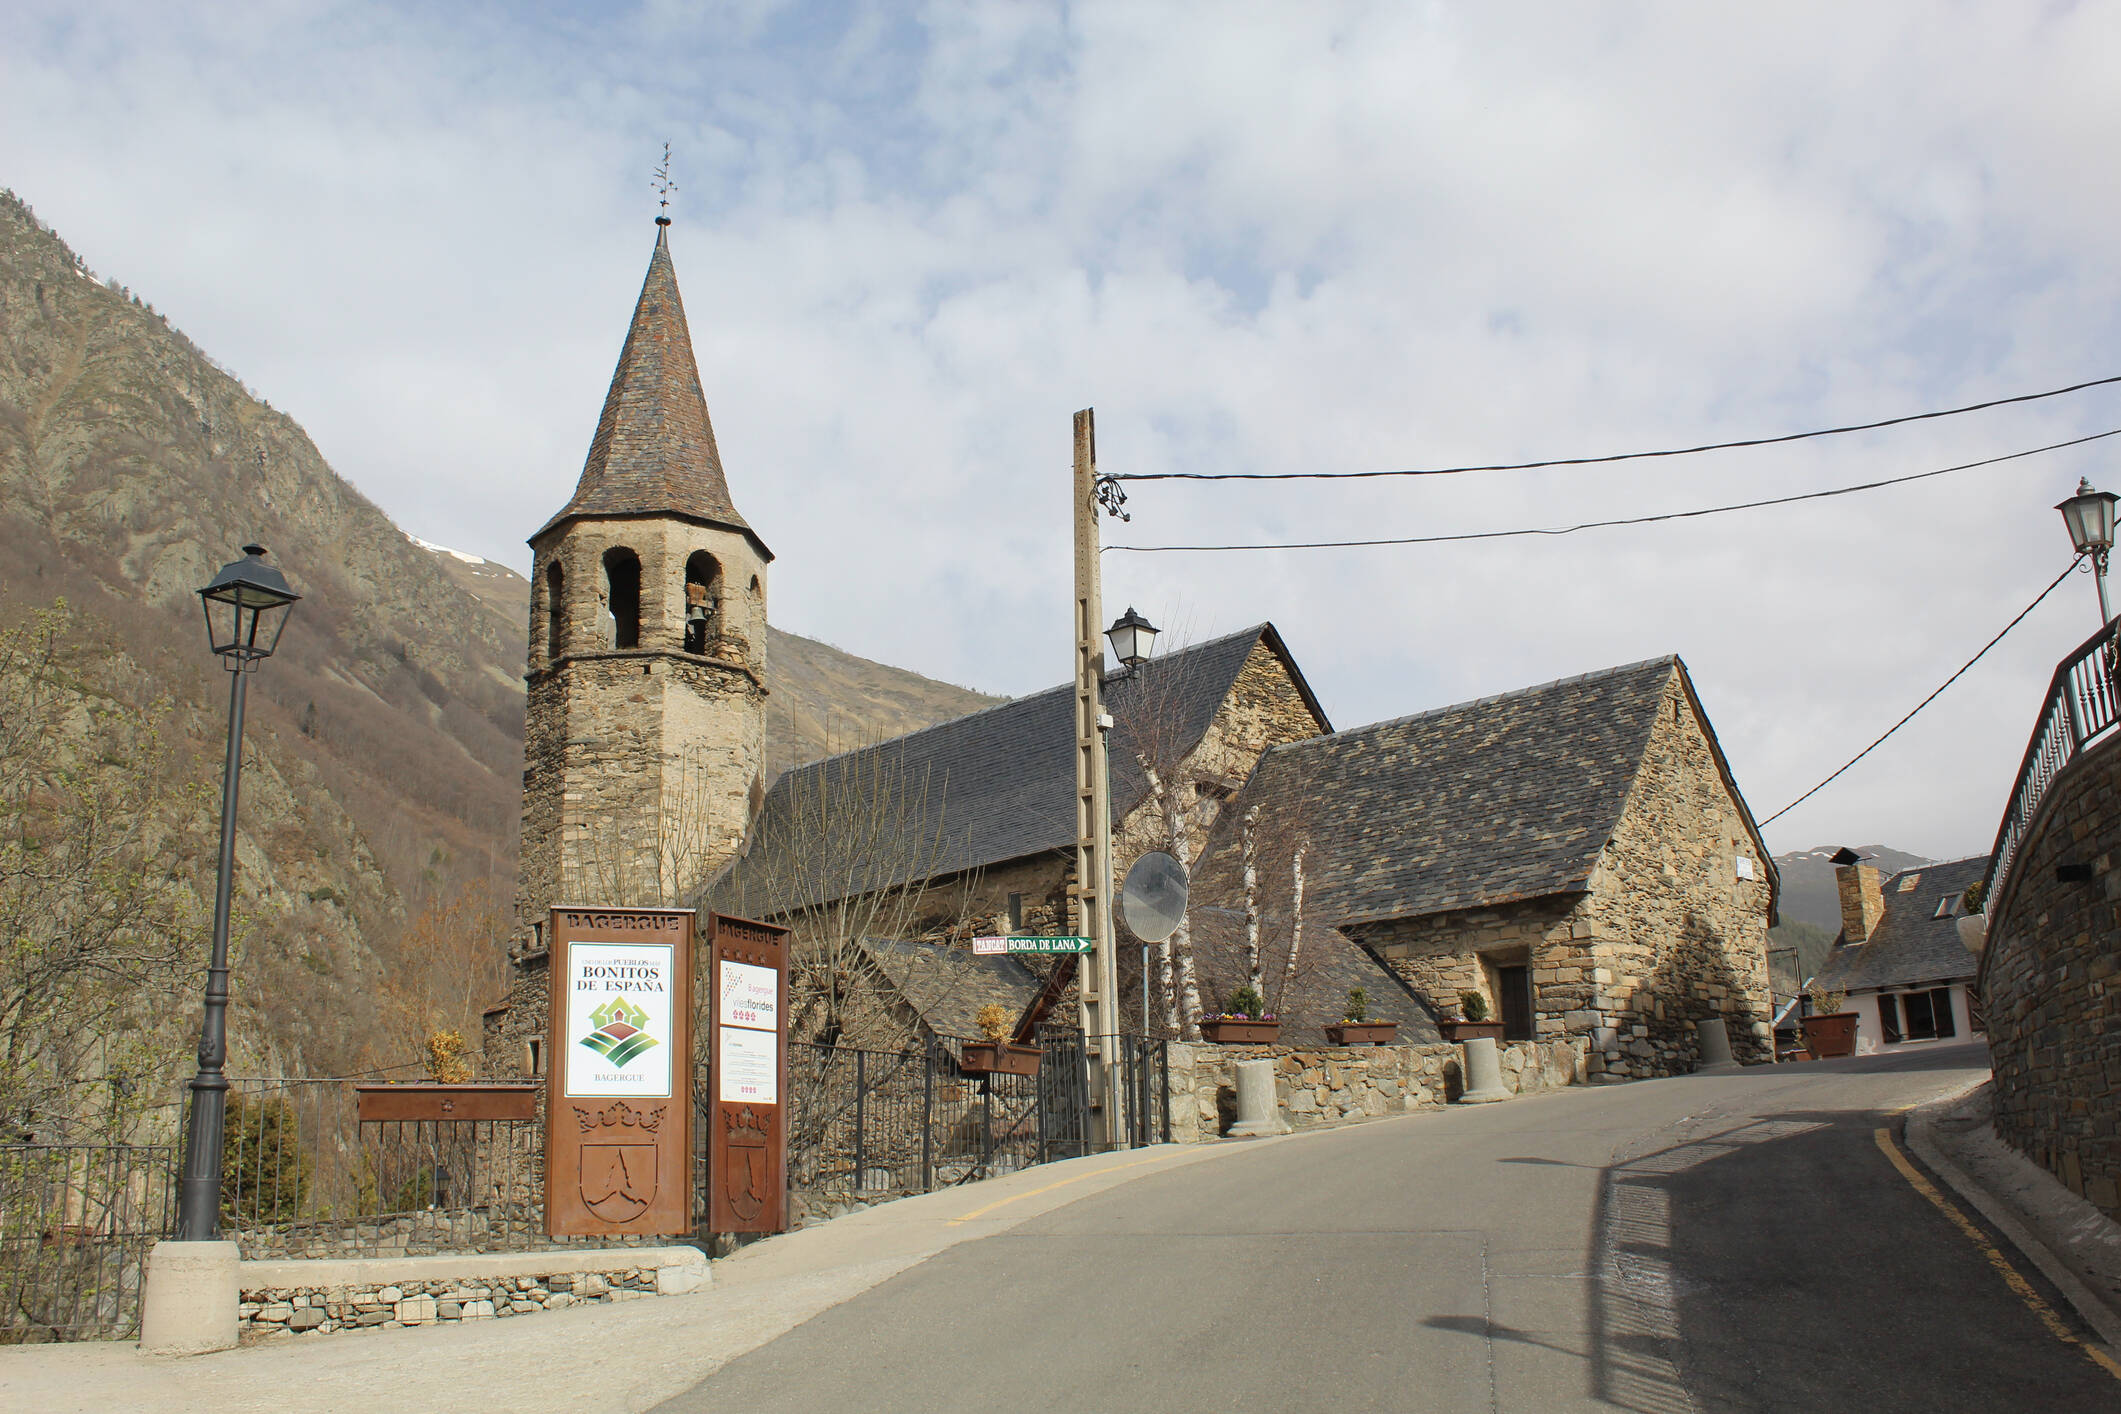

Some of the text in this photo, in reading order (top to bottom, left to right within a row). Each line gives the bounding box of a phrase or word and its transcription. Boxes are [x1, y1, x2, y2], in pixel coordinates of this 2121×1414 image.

[567, 914, 679, 930] BAGERGUE
[1008, 939, 1077, 951] BORDA DE LANA
[583, 966, 660, 979] BONITOS
[577, 979, 665, 992] DE ESPAÑA
[594, 1073, 644, 1081] BAGERGUE
